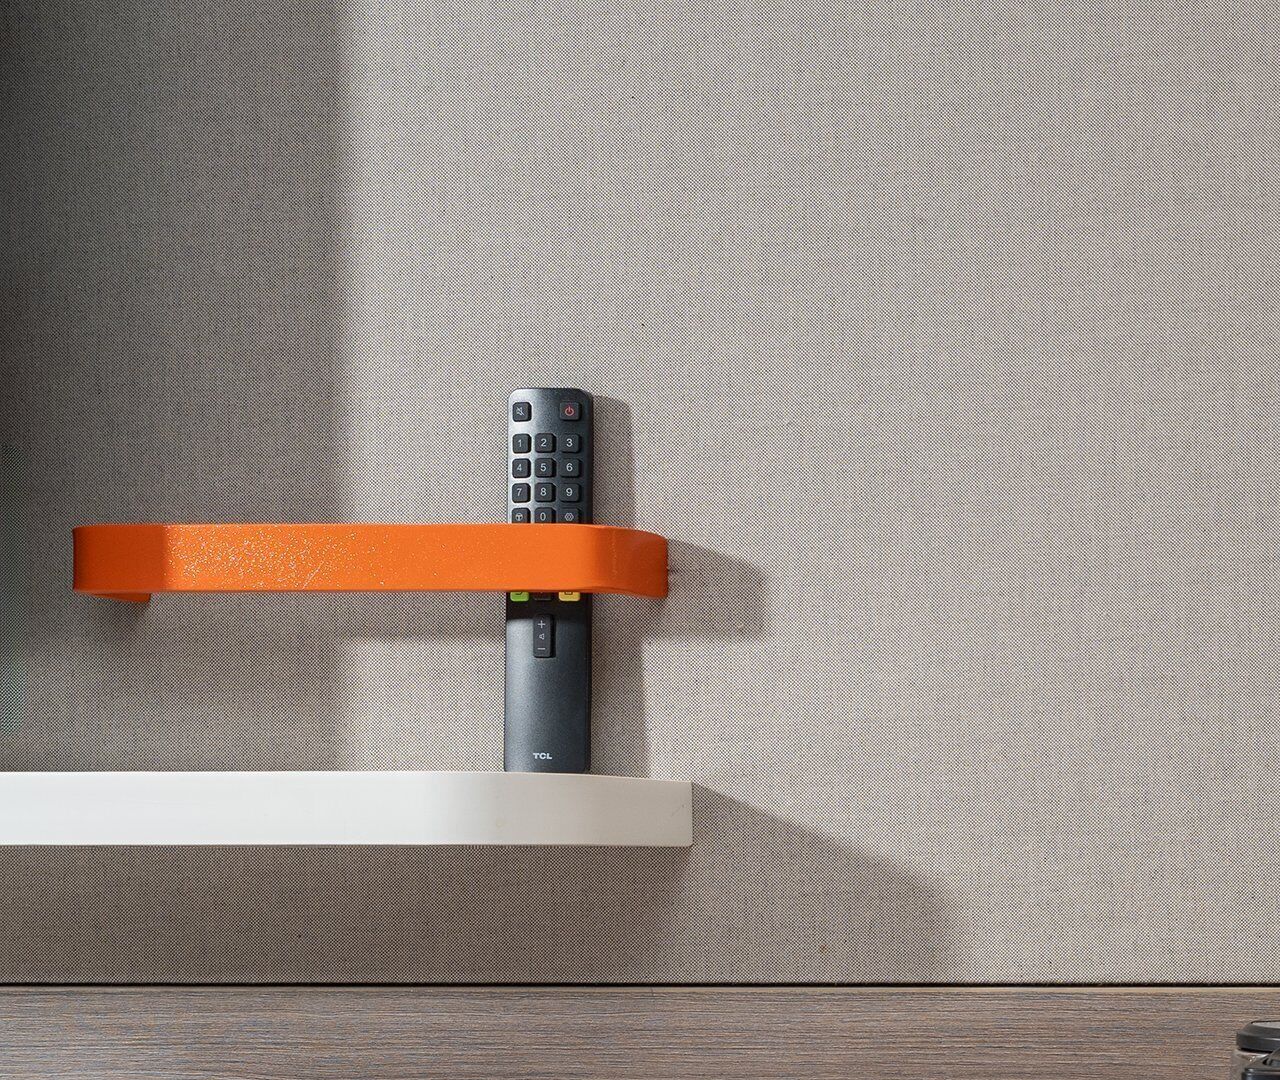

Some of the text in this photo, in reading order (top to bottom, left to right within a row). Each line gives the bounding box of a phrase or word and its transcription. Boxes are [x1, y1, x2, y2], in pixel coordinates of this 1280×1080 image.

[540, 438, 547, 447] 2
[566, 438, 573, 447] 3
[540, 463, 547, 472] 5
[566, 462, 573, 472] 6
[540, 487, 547, 496] 8
[566, 487, 573, 497] 9
[533, 752, 552, 760] TCL
